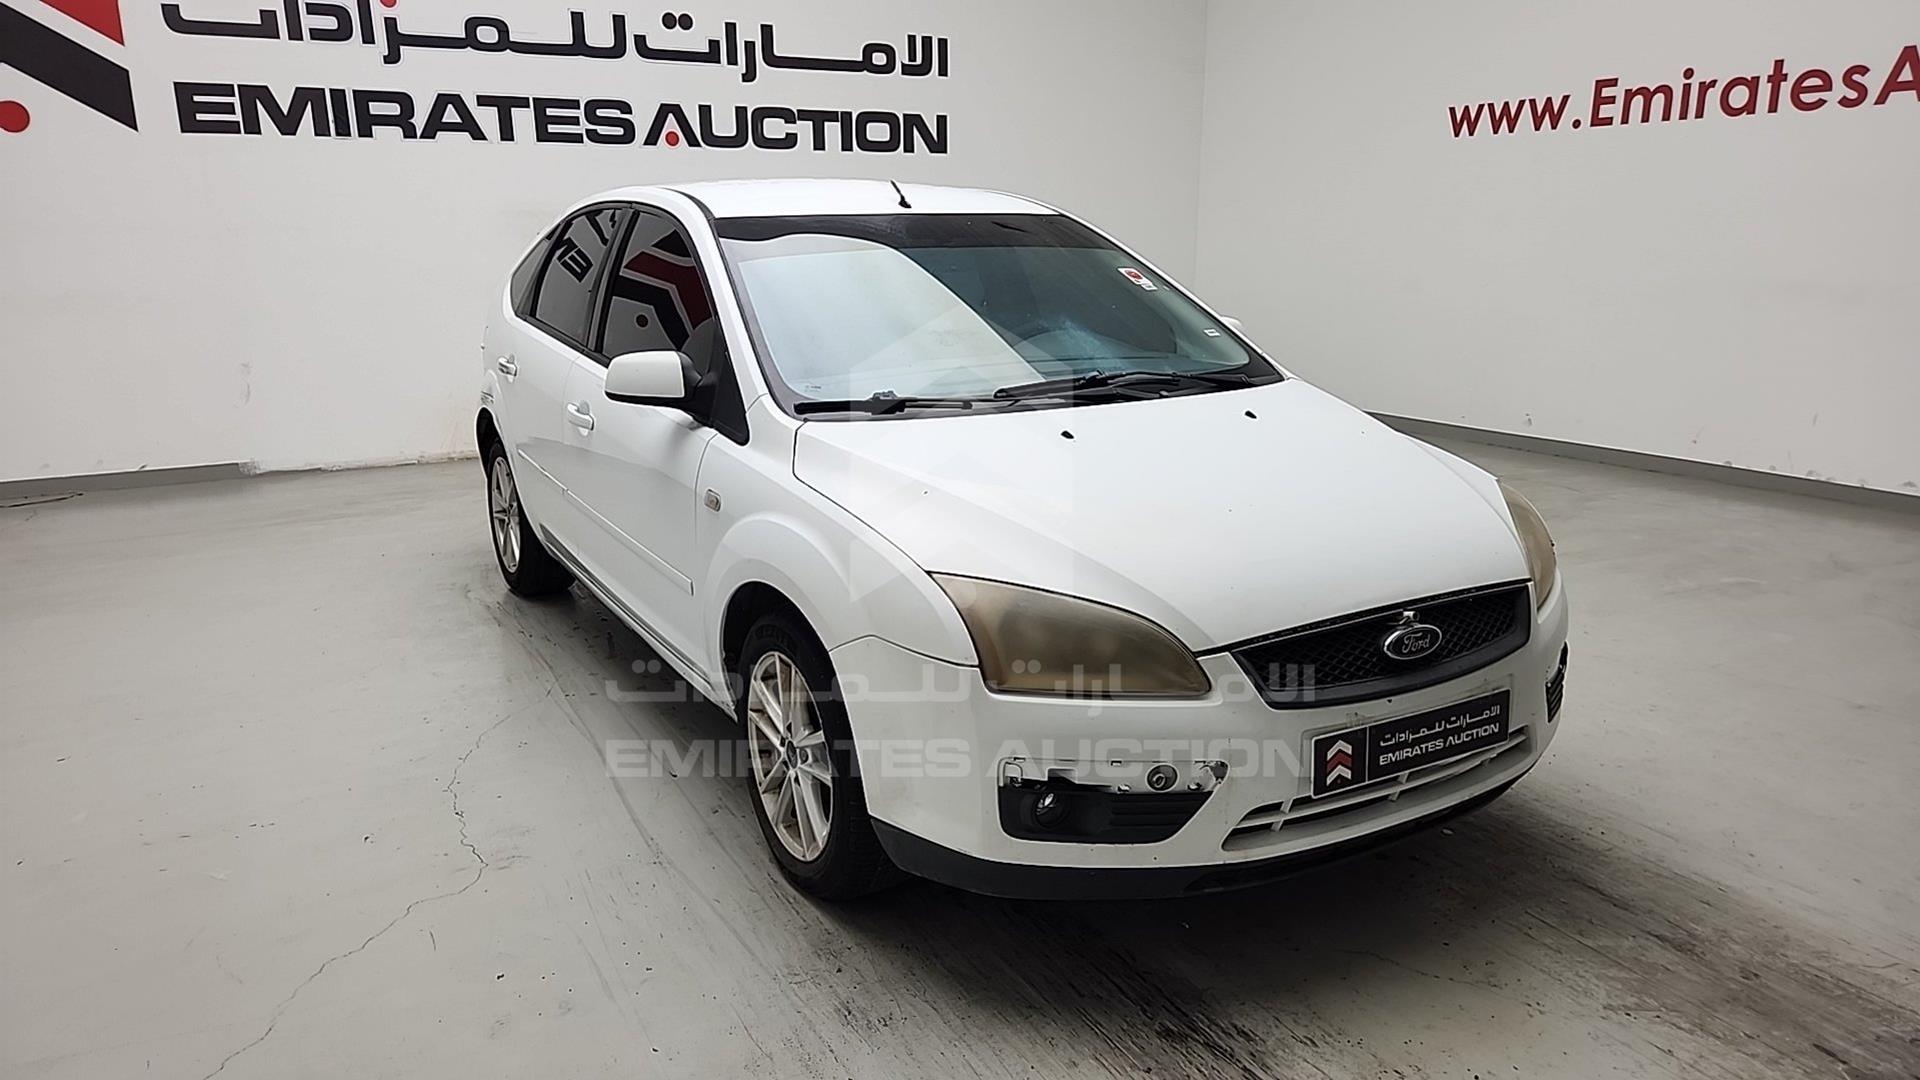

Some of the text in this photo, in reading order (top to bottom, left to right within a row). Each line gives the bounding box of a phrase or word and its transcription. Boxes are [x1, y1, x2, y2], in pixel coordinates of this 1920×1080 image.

[173, 81, 948, 154] EMIRATES AUCTION
[1402, 632, 1431, 653] Ford
[1379, 722, 1500, 766] EMIRATES AUCTION
